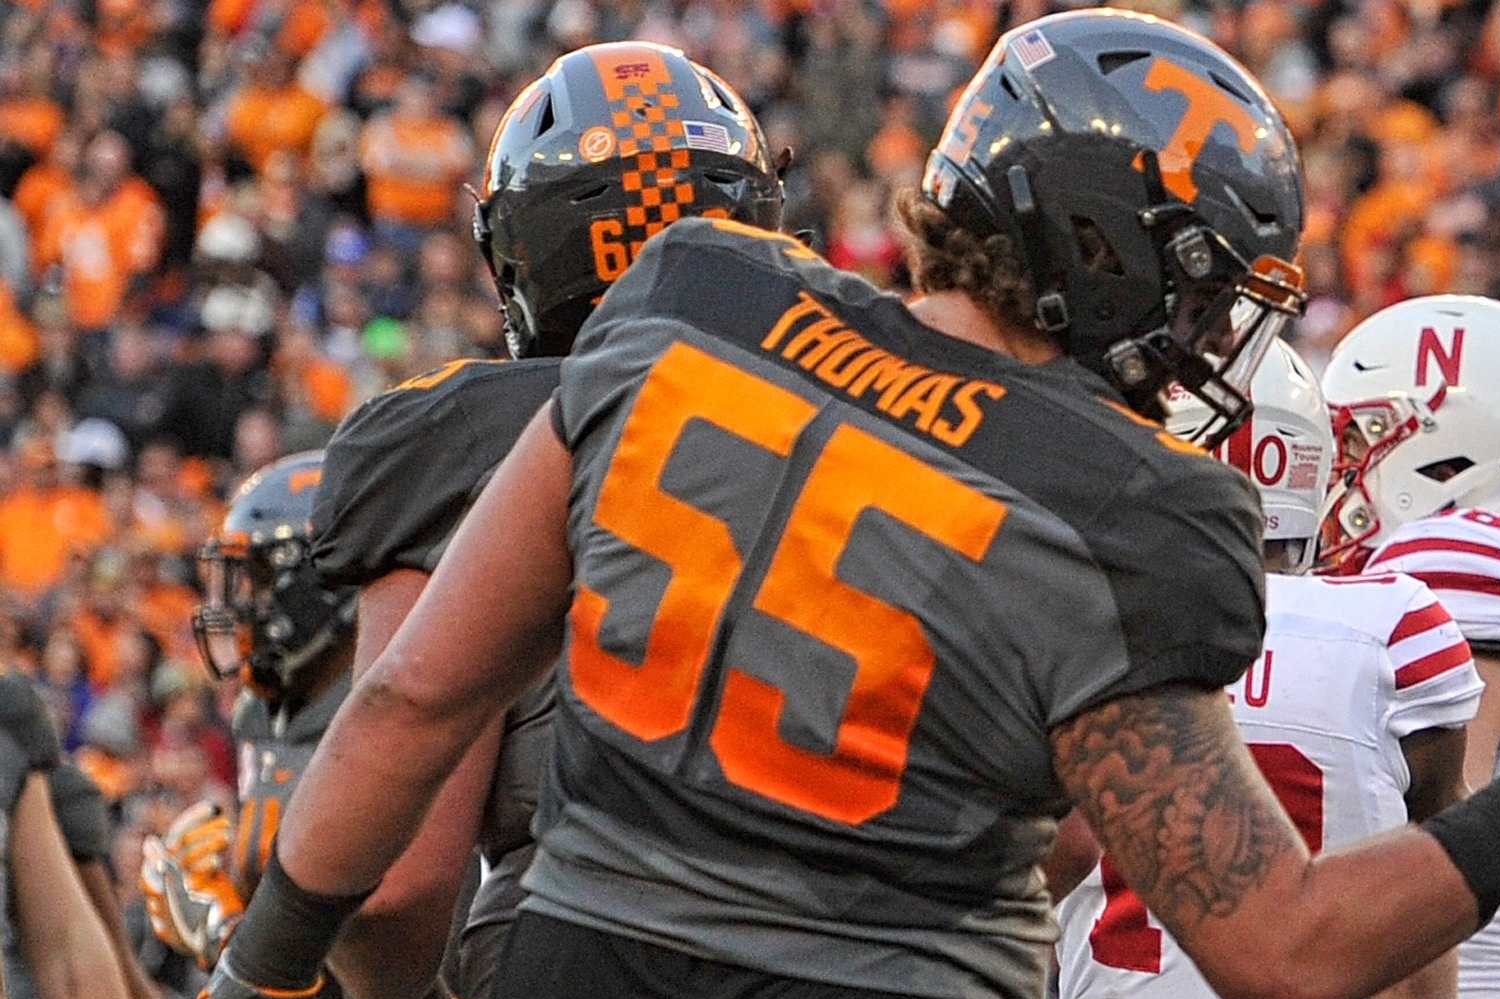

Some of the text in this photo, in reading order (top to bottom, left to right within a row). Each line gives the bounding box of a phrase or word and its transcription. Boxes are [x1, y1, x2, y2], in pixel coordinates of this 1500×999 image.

[1131, 57, 1260, 205] T
[760, 290, 1008, 449] THOMAS
[1414, 327, 1465, 388] N
[568, 340, 1009, 826] 55
